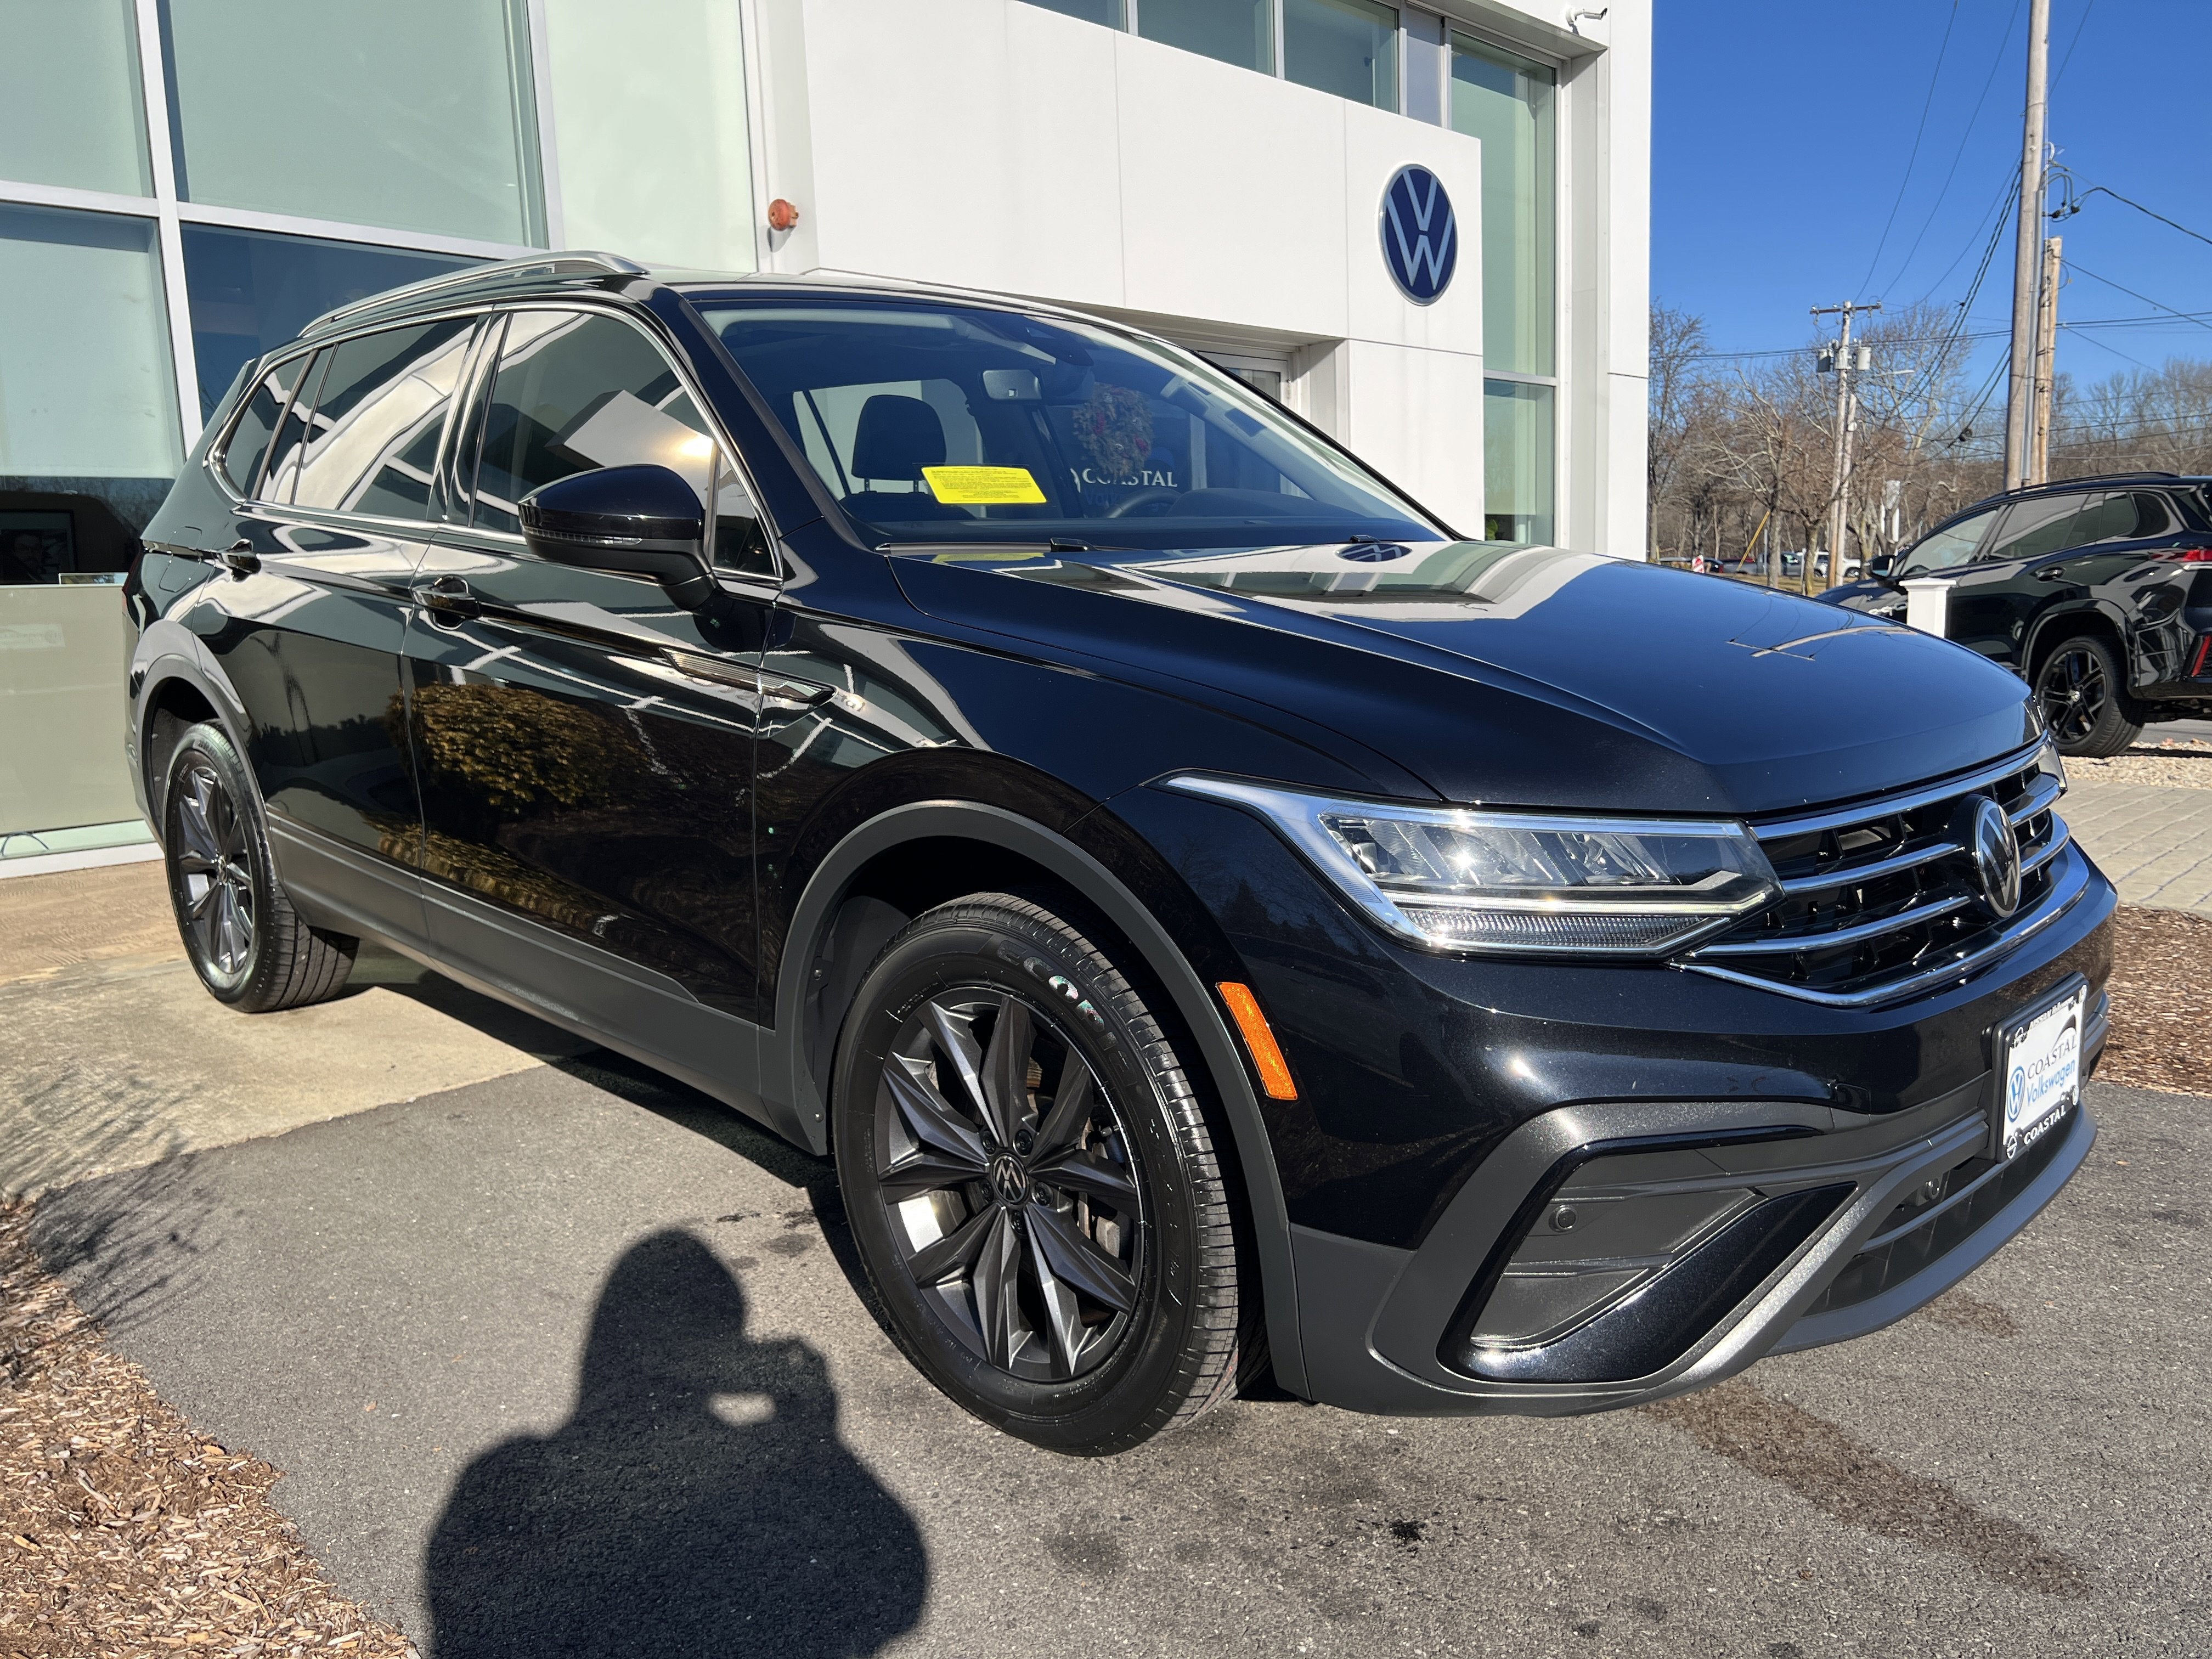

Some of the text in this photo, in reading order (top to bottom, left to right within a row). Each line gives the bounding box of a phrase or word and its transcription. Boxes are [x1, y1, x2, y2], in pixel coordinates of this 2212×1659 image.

[1381, 166, 1456, 298] VW
[2028, 1034, 2077, 1079] COASTAL
[2008, 1069, 2024, 1119] VW
[2027, 1059, 2075, 1107] Volkswagen
[2024, 1105, 2066, 1145] COASTAL
